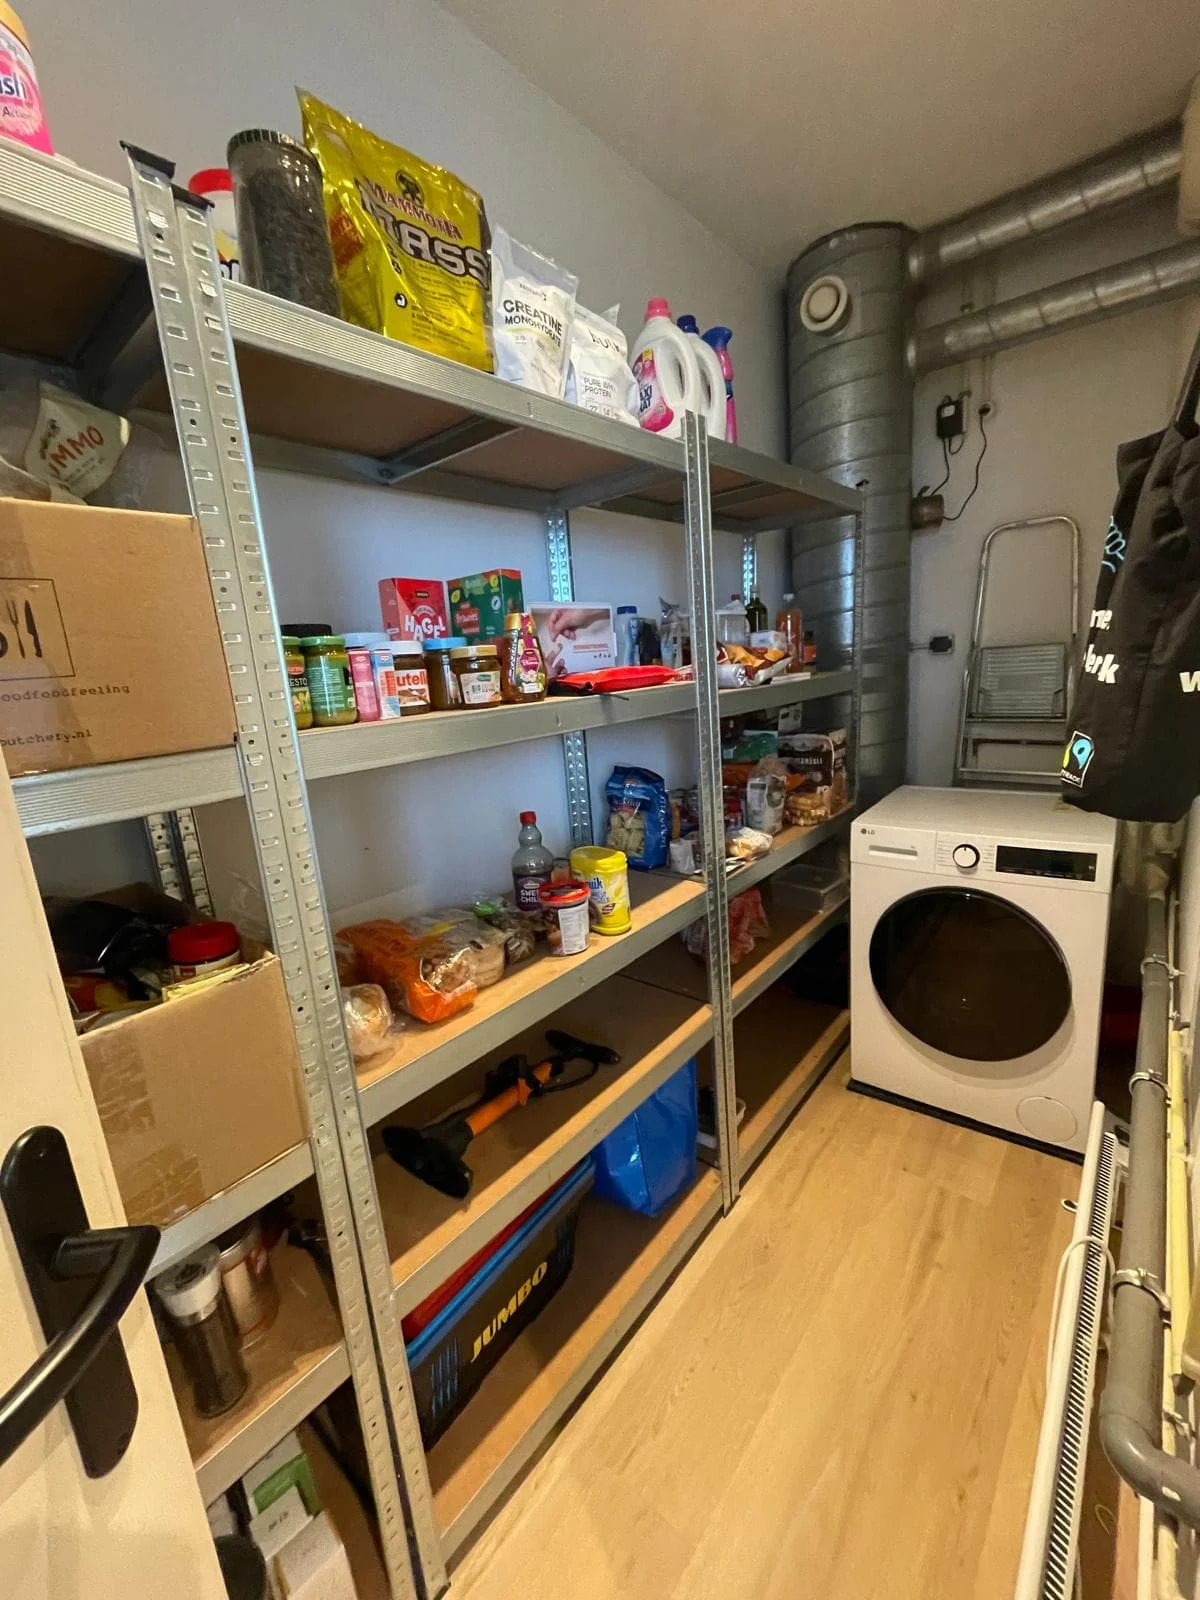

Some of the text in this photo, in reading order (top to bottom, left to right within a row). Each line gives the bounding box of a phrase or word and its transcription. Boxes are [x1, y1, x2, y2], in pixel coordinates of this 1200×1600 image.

[503, 299, 562, 337] CREATINE
[504, 315, 561, 348] MONOHYDRATE
[404, 614, 447, 641] HAGEL
[396, 670, 427, 687] utell
[470, 1260, 548, 1363] JUMBO
